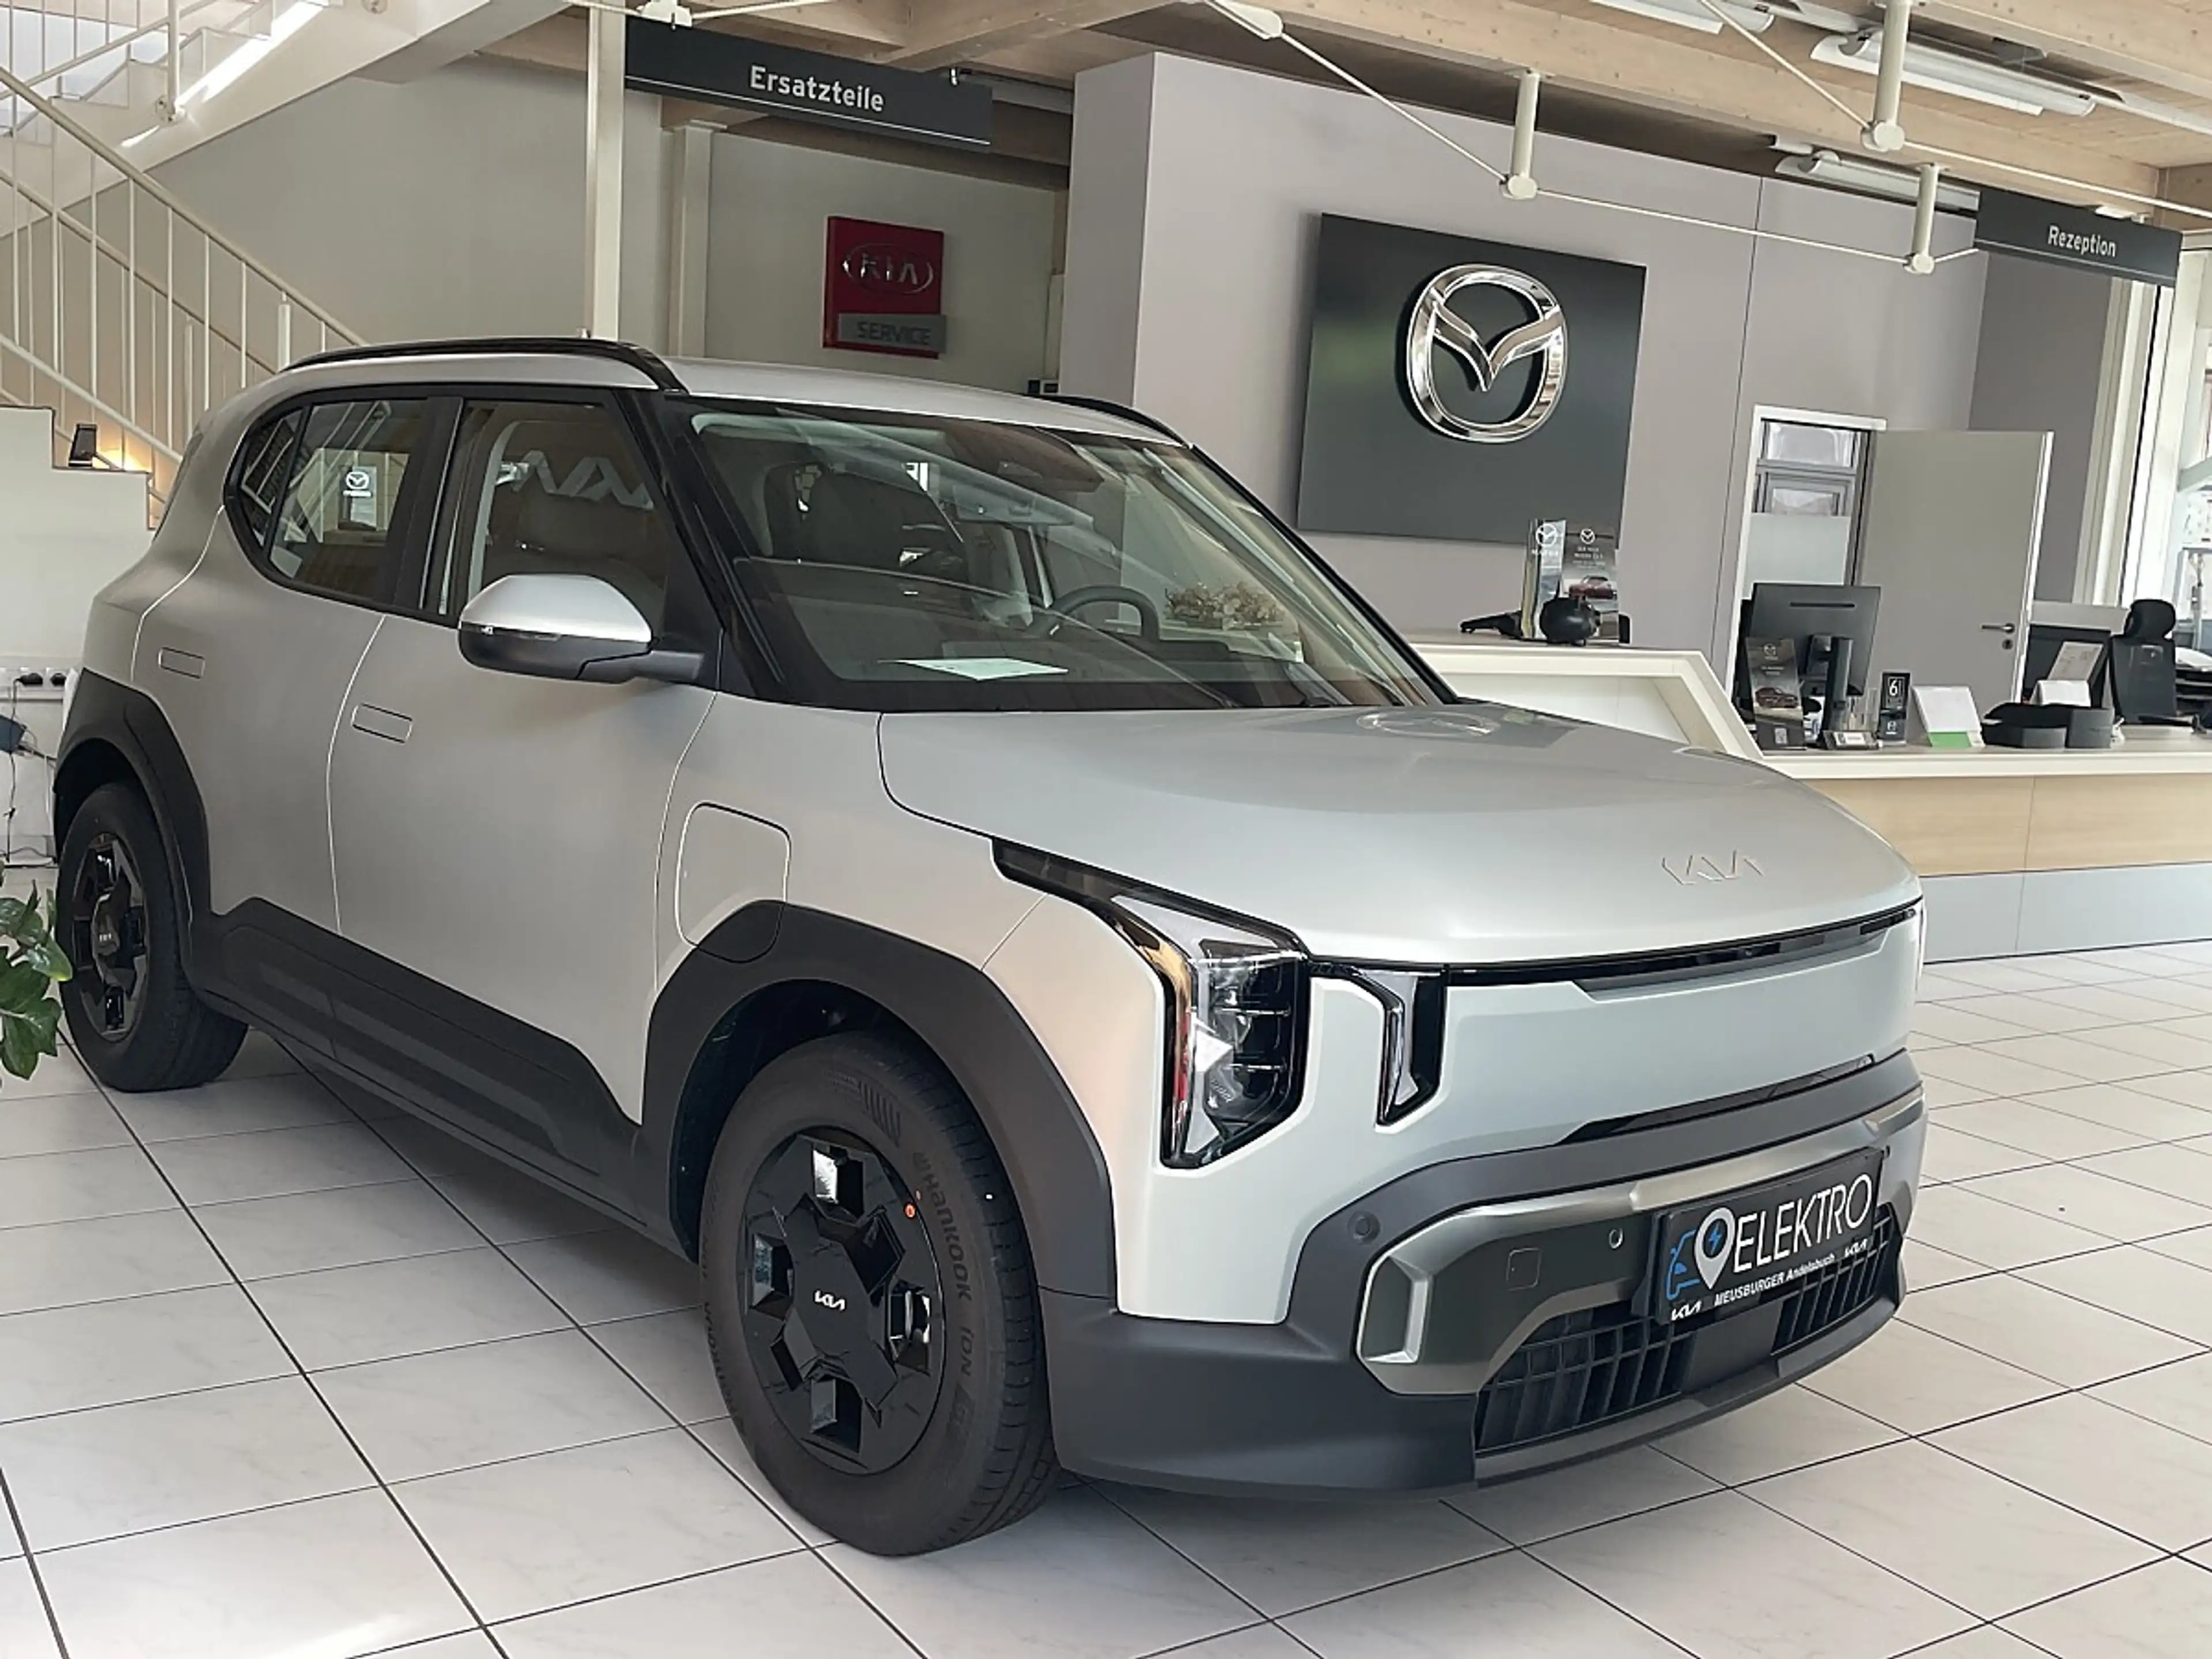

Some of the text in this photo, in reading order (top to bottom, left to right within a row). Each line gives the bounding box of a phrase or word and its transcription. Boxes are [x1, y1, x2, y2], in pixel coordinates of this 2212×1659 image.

[750, 64, 884, 112] Ersatzteile
[2047, 224, 2116, 258] Rezeption
[860, 252, 919, 286] KIA
[857, 320, 931, 346] SERVICE
[1733, 1173, 1872, 1273] ELEKTRO
[1714, 1271, 1785, 1307] MEUSBURGER
